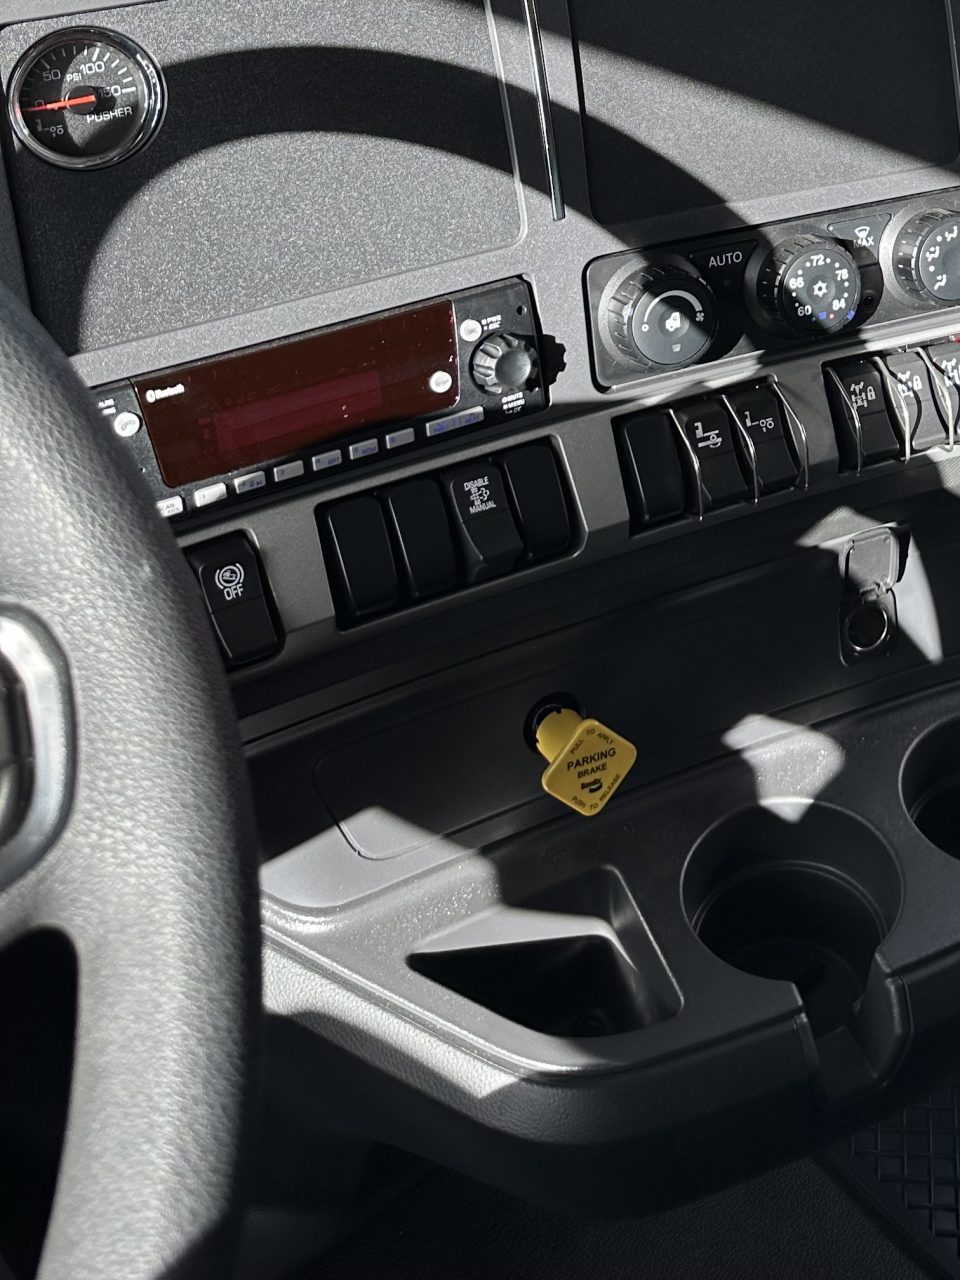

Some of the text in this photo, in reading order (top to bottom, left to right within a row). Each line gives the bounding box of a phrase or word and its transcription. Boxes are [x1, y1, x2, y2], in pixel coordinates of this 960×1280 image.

[79, 61, 105, 75] 100
[42, 69, 61, 81] 50
[66, 72, 82, 82] PSI
[98, 85, 121, 97] 150
[86, 106, 133, 123] PUSHER
[853, 236, 874, 249] MAX
[708, 251, 743, 268] AUTO
[811, 254, 825, 267] 72
[836, 269, 849, 281] 78
[789, 277, 804, 289] 66
[797, 305, 812, 317] 60
[832, 298, 846, 311] 84
[508, 399, 525, 408] MENU
[464, 476, 489, 491] DISABLE
[470, 500, 496, 514] MANUAL
[224, 583, 244, 600] OFF
[567, 747, 617, 771] PARKING
[577, 762, 607, 779] BRAKE
